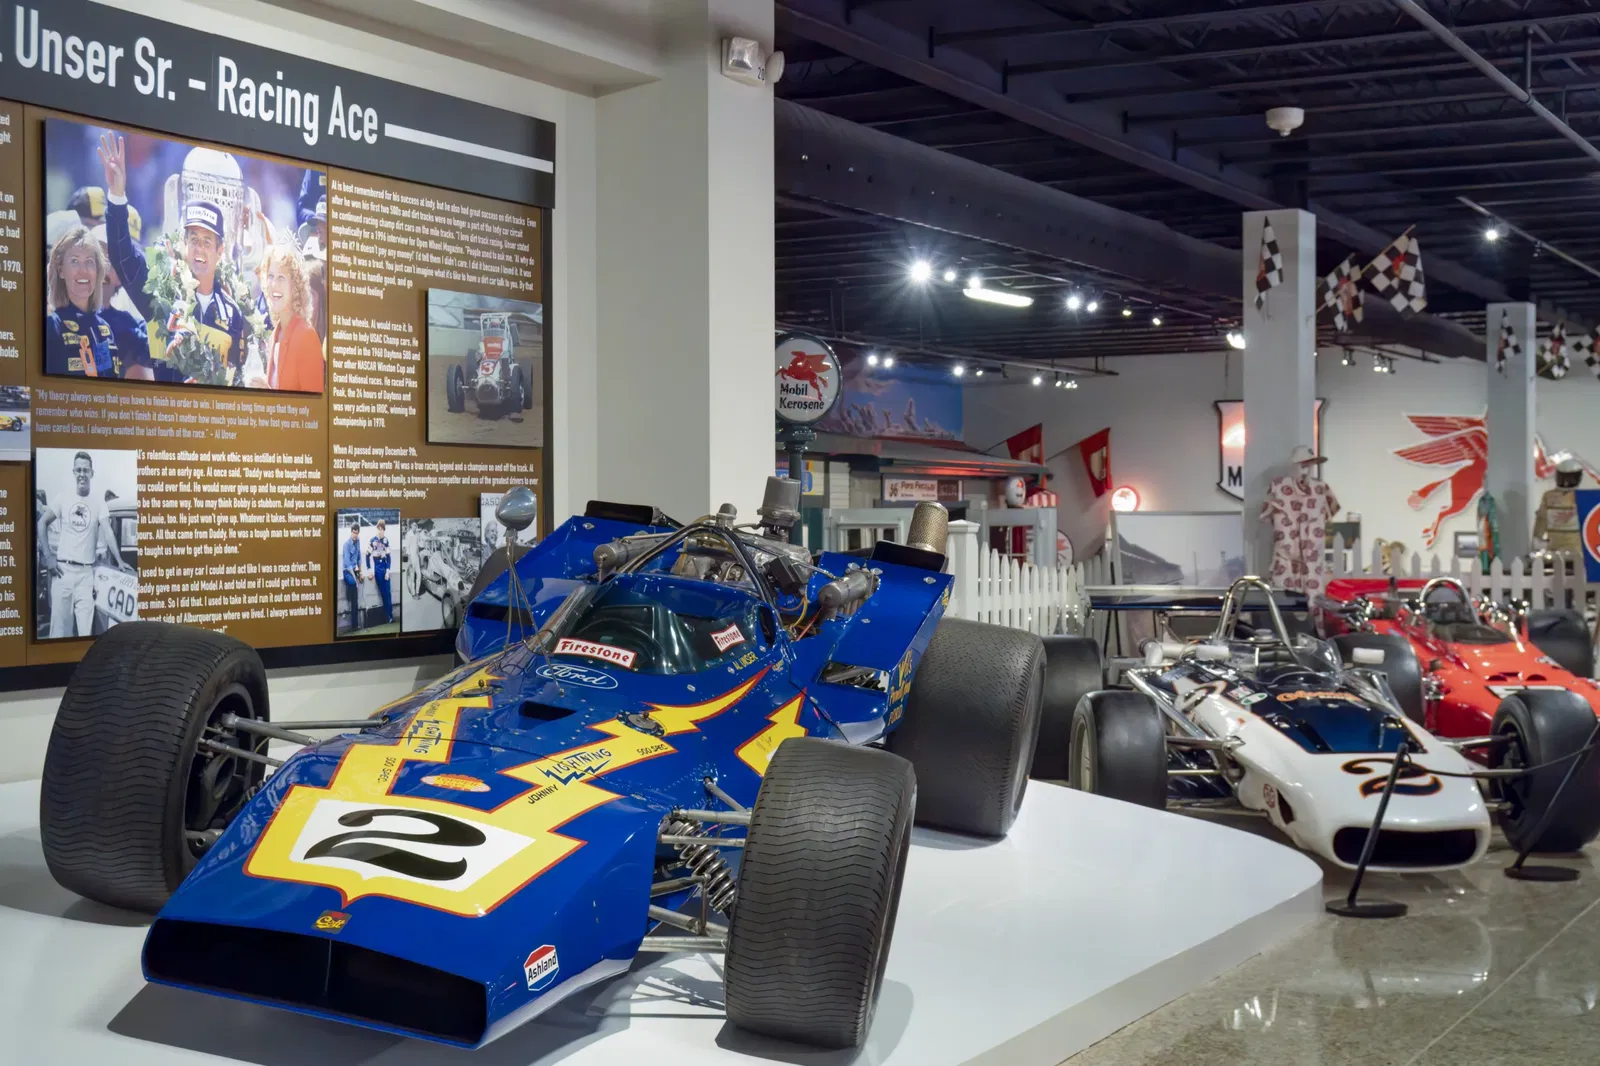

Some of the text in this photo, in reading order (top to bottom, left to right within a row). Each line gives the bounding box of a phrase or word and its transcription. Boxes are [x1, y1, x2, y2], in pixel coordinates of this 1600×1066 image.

[16, 5, 124, 87] Unser
[134, 37, 176, 101] Sr.
[218, 56, 320, 146] Racing
[328, 86, 378, 145] Ace
[6, 225, 20, 239] had
[780, 382, 808, 396] Mobil
[779, 397, 824, 410] Kerosene
[137, 465, 160, 476] rothers
[108, 586, 135, 616] CAD
[715, 630, 740, 647] Firestone
[560, 641, 630, 662] Firestone
[543, 665, 607, 685] Ford
[636, 747, 650, 756] 500
[538, 747, 613, 785] LIGHTNING
[1342, 758, 1442, 799] 2
[528, 784, 558, 804] JOHNNY
[304, 808, 486, 880] 2
[527, 954, 558, 980] Ashland
